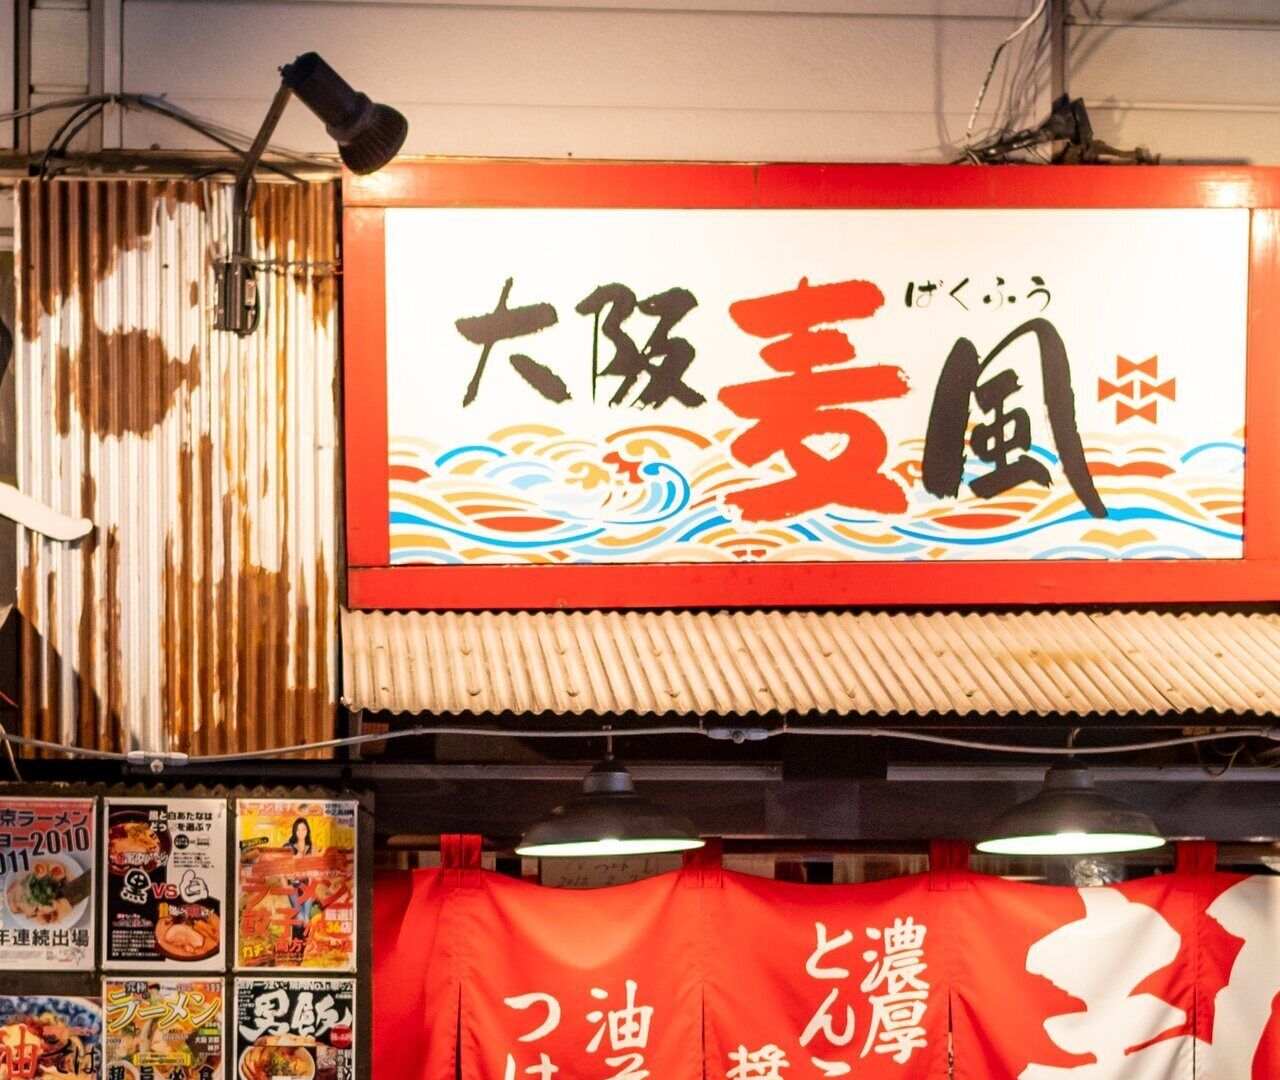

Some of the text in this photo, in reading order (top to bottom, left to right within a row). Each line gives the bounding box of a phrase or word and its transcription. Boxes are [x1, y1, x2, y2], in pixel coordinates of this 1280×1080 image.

[455, 272, 1108, 523] 大阪麦風
[30, 826, 91, 857] 2010
[151, 882, 179, 899] VS
[106, 991, 221, 1032] ラーメン
[860, 916, 931, 1066] 濃厚
